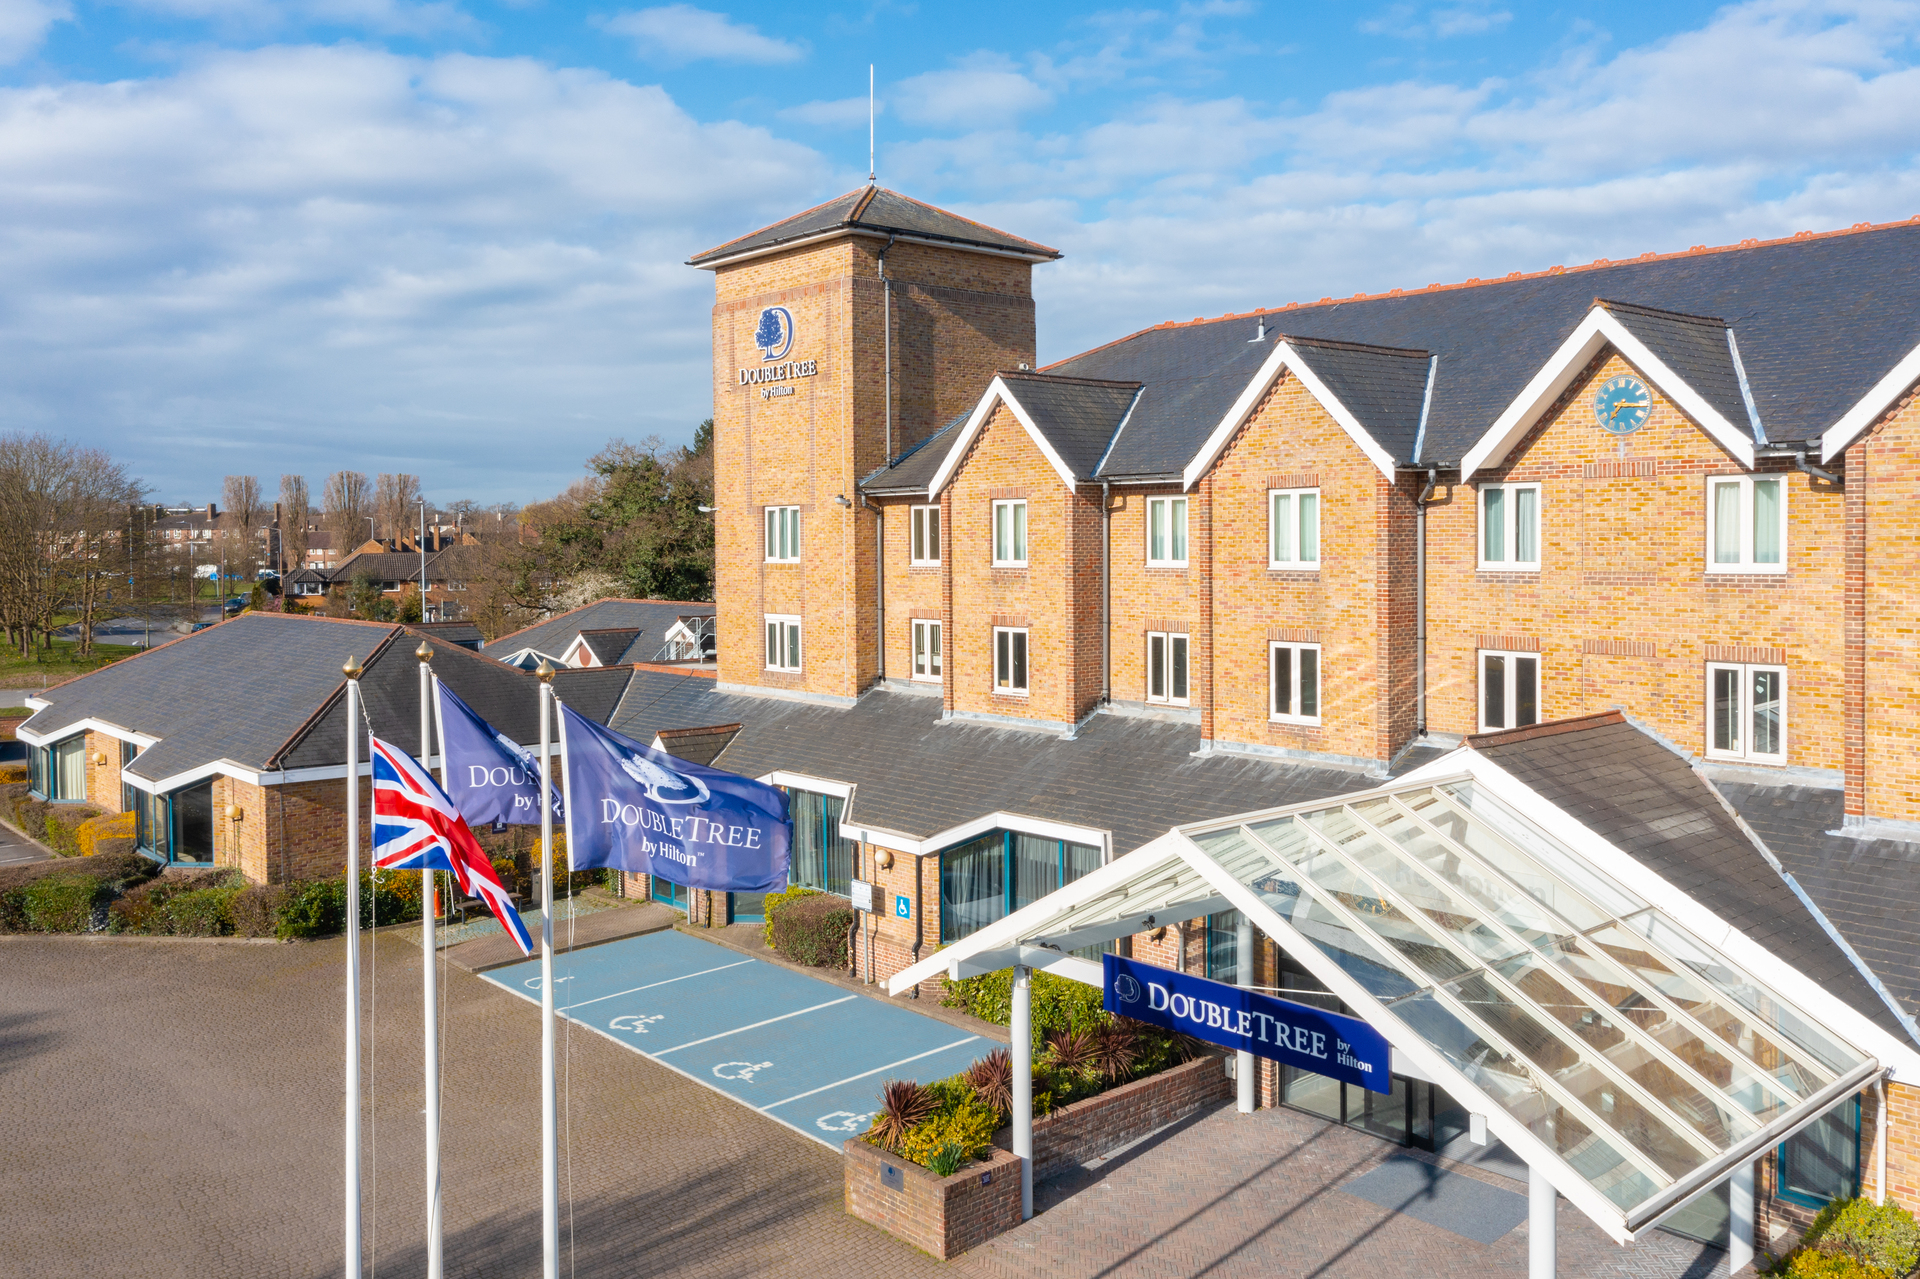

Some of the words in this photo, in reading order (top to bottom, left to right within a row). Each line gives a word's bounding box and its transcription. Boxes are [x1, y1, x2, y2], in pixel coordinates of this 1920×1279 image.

[739, 360, 817, 385] DOUBLETREE
[761, 387, 770, 399] by
[770, 385, 793, 397] Hilton
[514, 793, 533, 810] by
[601, 798, 762, 849] DOUBLETREE
[641, 836, 657, 857] by
[1148, 982, 1328, 1060] DOUBLETREE
[1337, 1038, 1350, 1054] by
[1337, 1052, 1373, 1073] Hilton
